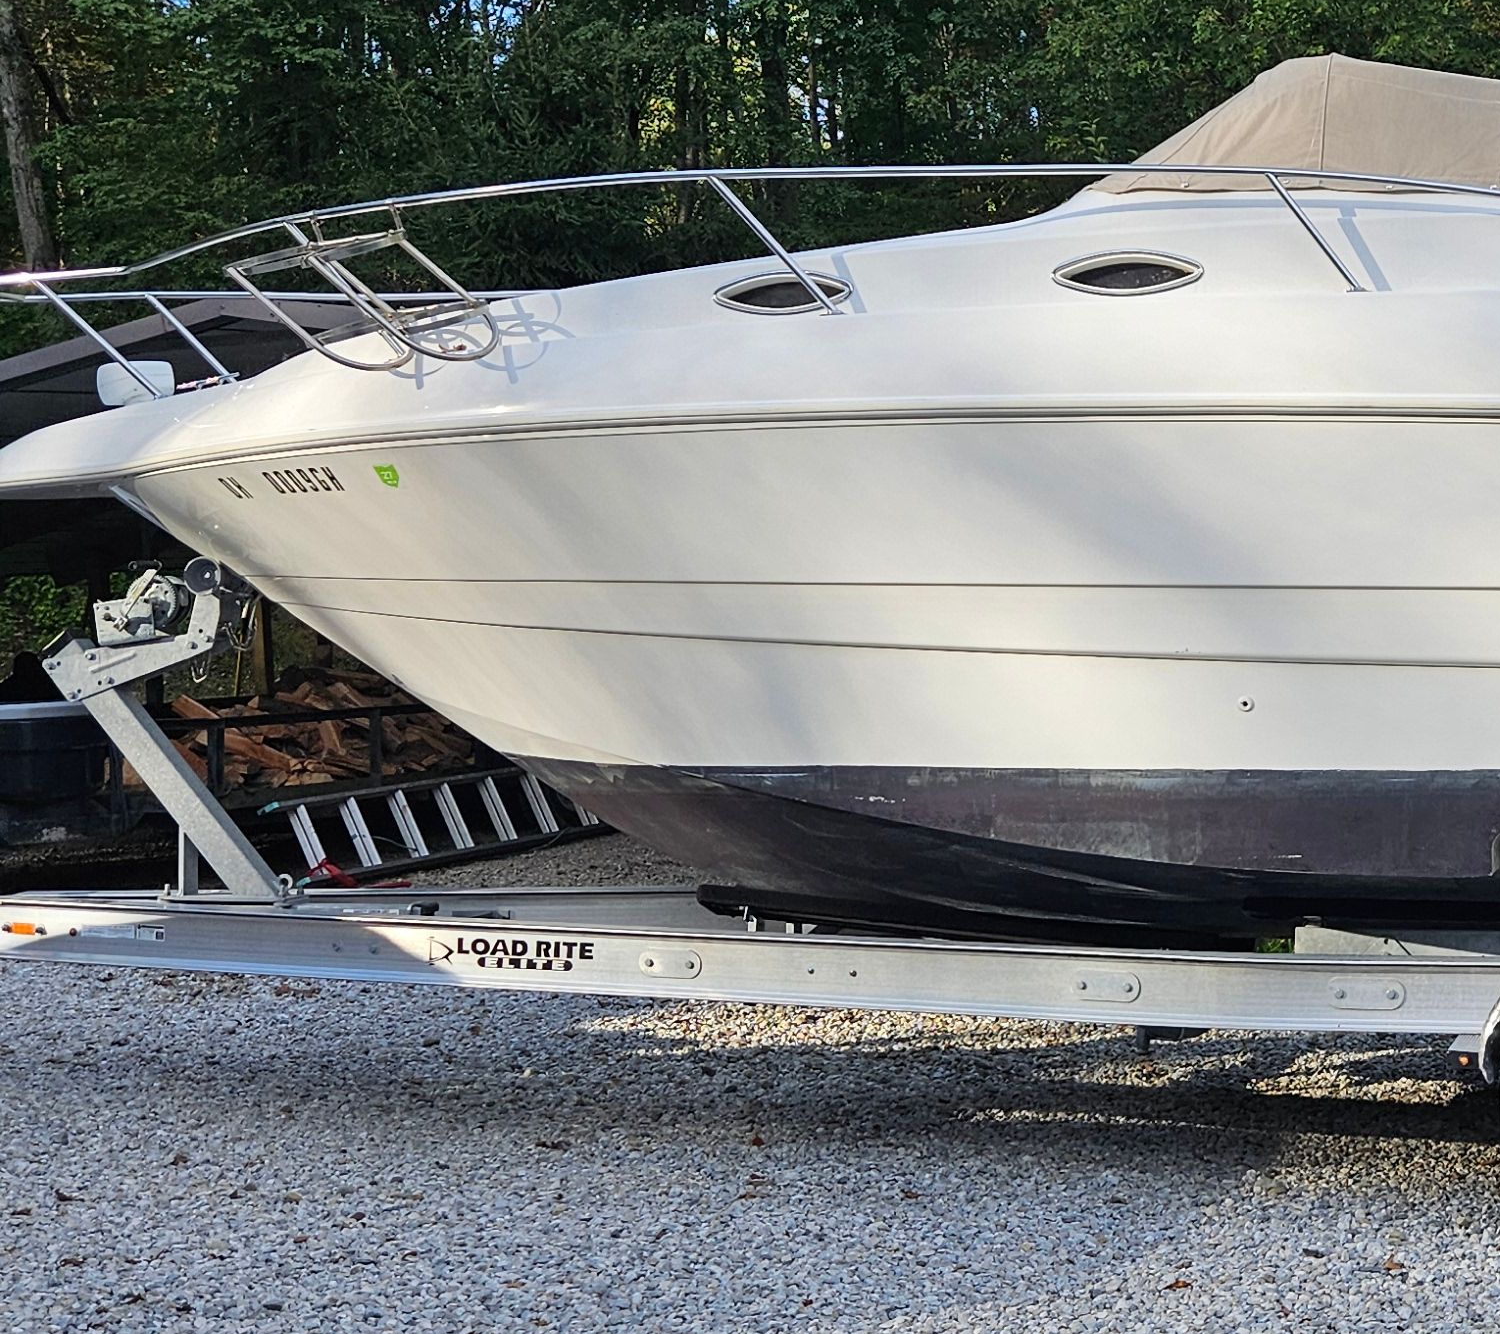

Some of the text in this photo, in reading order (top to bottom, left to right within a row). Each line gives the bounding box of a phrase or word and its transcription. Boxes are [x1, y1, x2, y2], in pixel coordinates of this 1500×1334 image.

[217, 476, 254, 499] OH
[457, 937, 595, 960] LOAD RITE
[483, 956, 567, 972] ELITE
